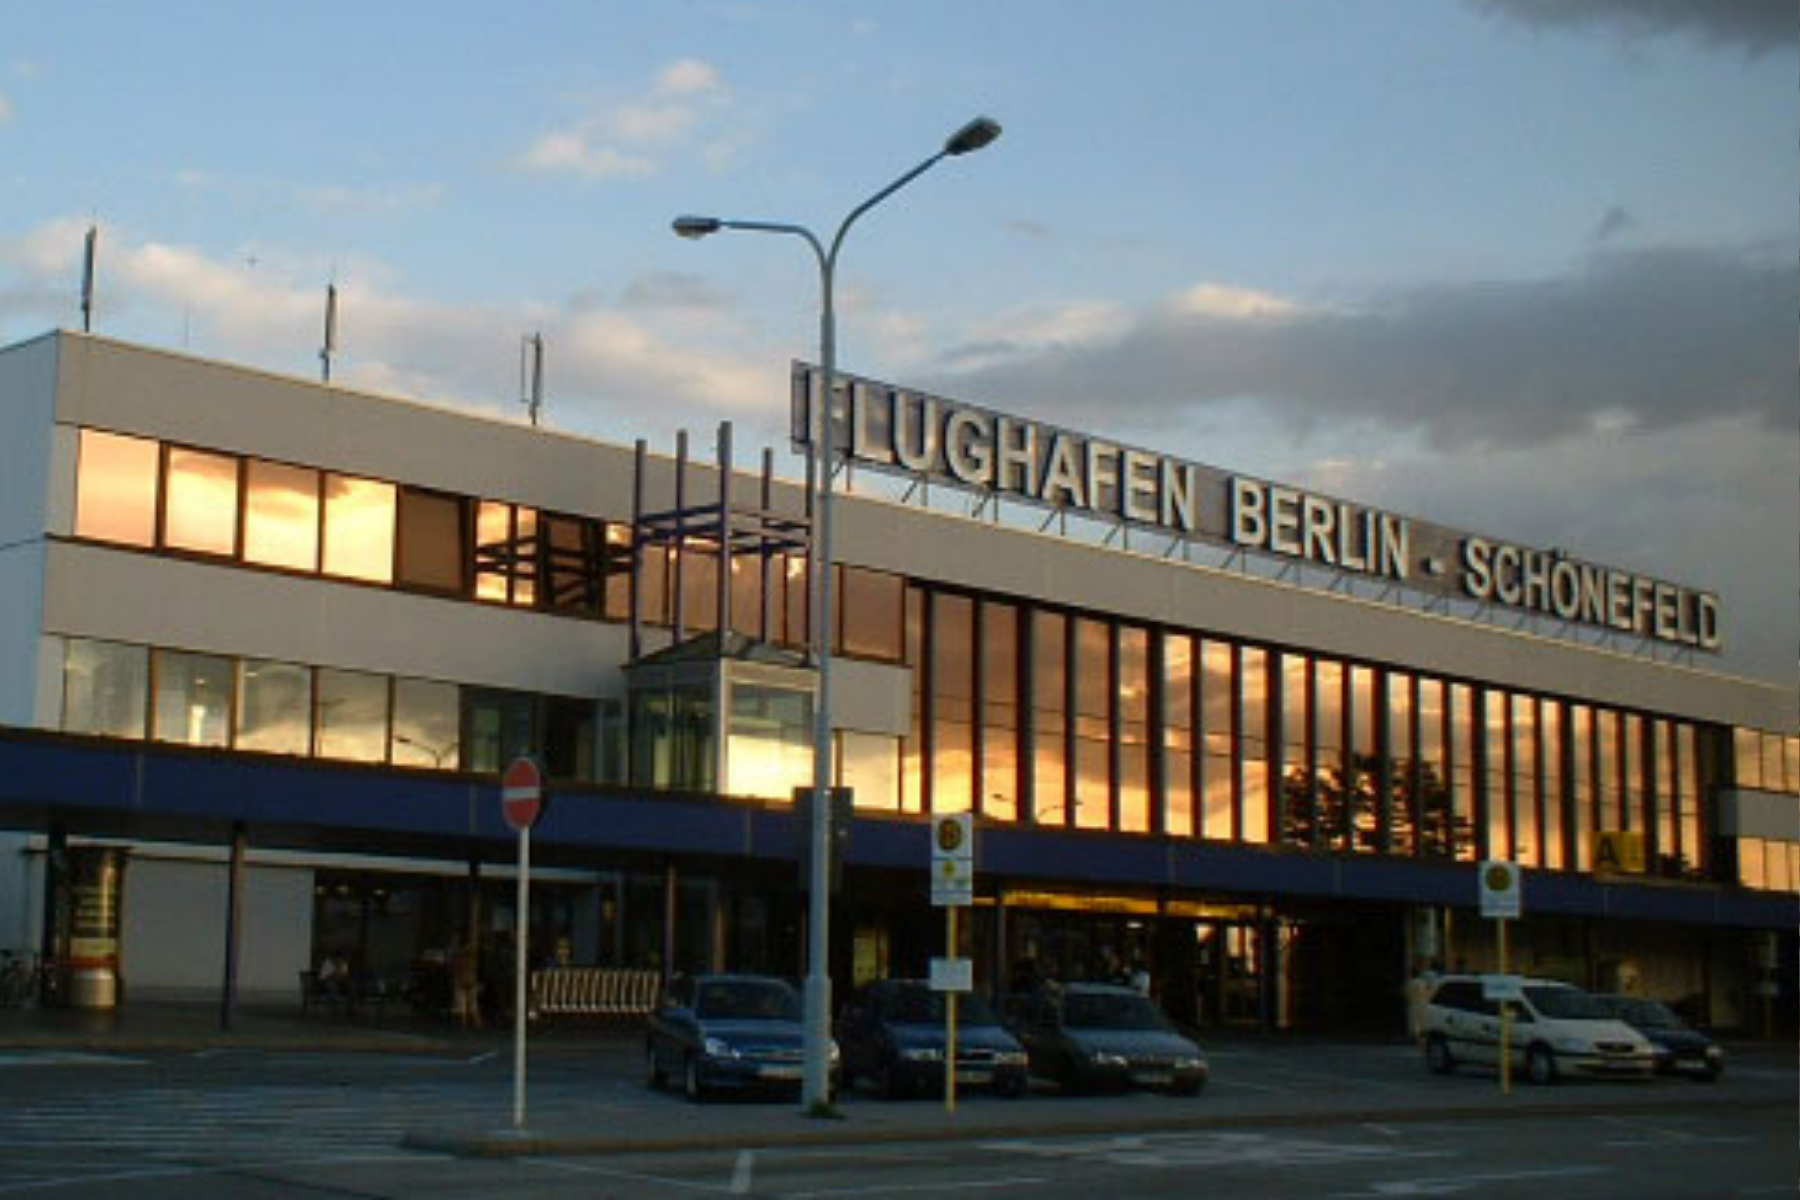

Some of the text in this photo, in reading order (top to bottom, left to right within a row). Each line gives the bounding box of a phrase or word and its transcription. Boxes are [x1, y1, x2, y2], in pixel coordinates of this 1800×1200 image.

[809, 370, 1196, 532] FLUGHAFEN
[1232, 475, 1410, 579] BERLIN
[1464, 537, 1721, 649] SCHÖNEFELD
